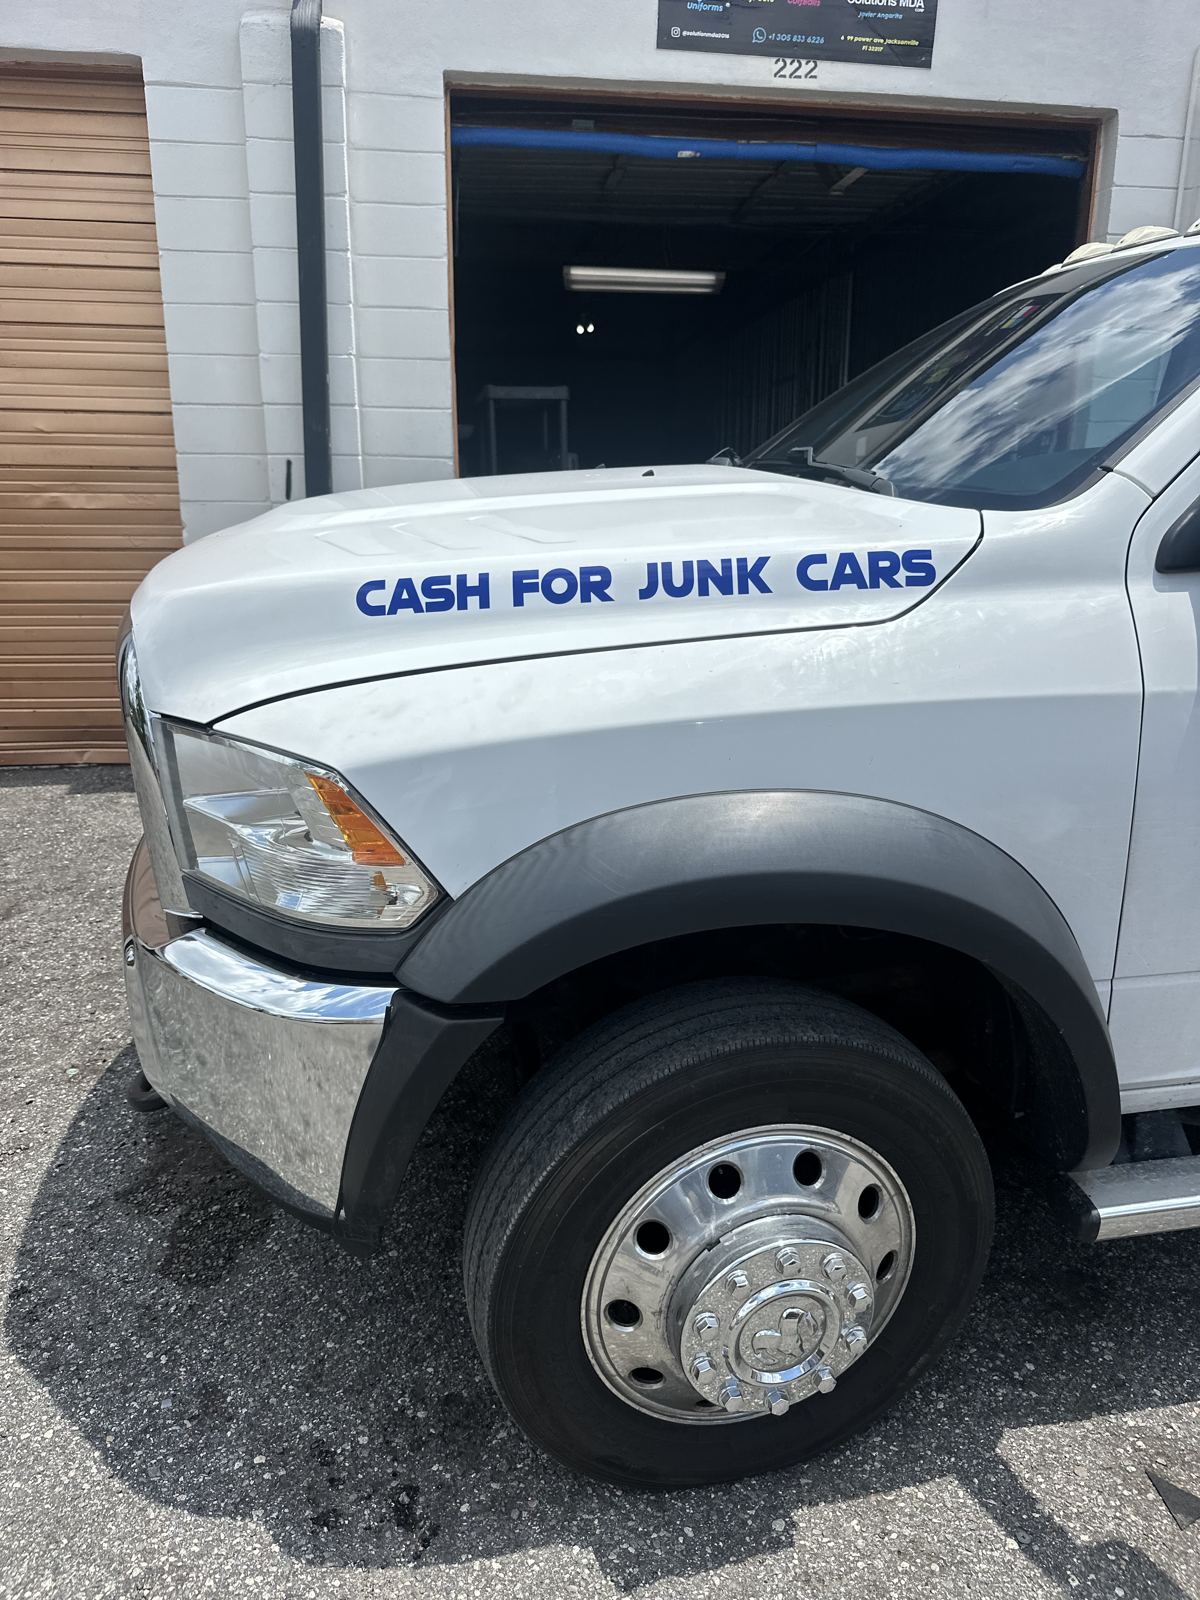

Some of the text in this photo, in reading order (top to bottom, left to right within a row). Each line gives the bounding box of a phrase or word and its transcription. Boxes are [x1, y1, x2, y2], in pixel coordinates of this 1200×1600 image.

[687, 2, 723, 11] Uniforms
[899, 0, 925, 8] MDA
[807, 36, 825, 44] 6226
[774, 58, 818, 79] 222
[356, 549, 936, 617] CASH FOR JUNK CARS
